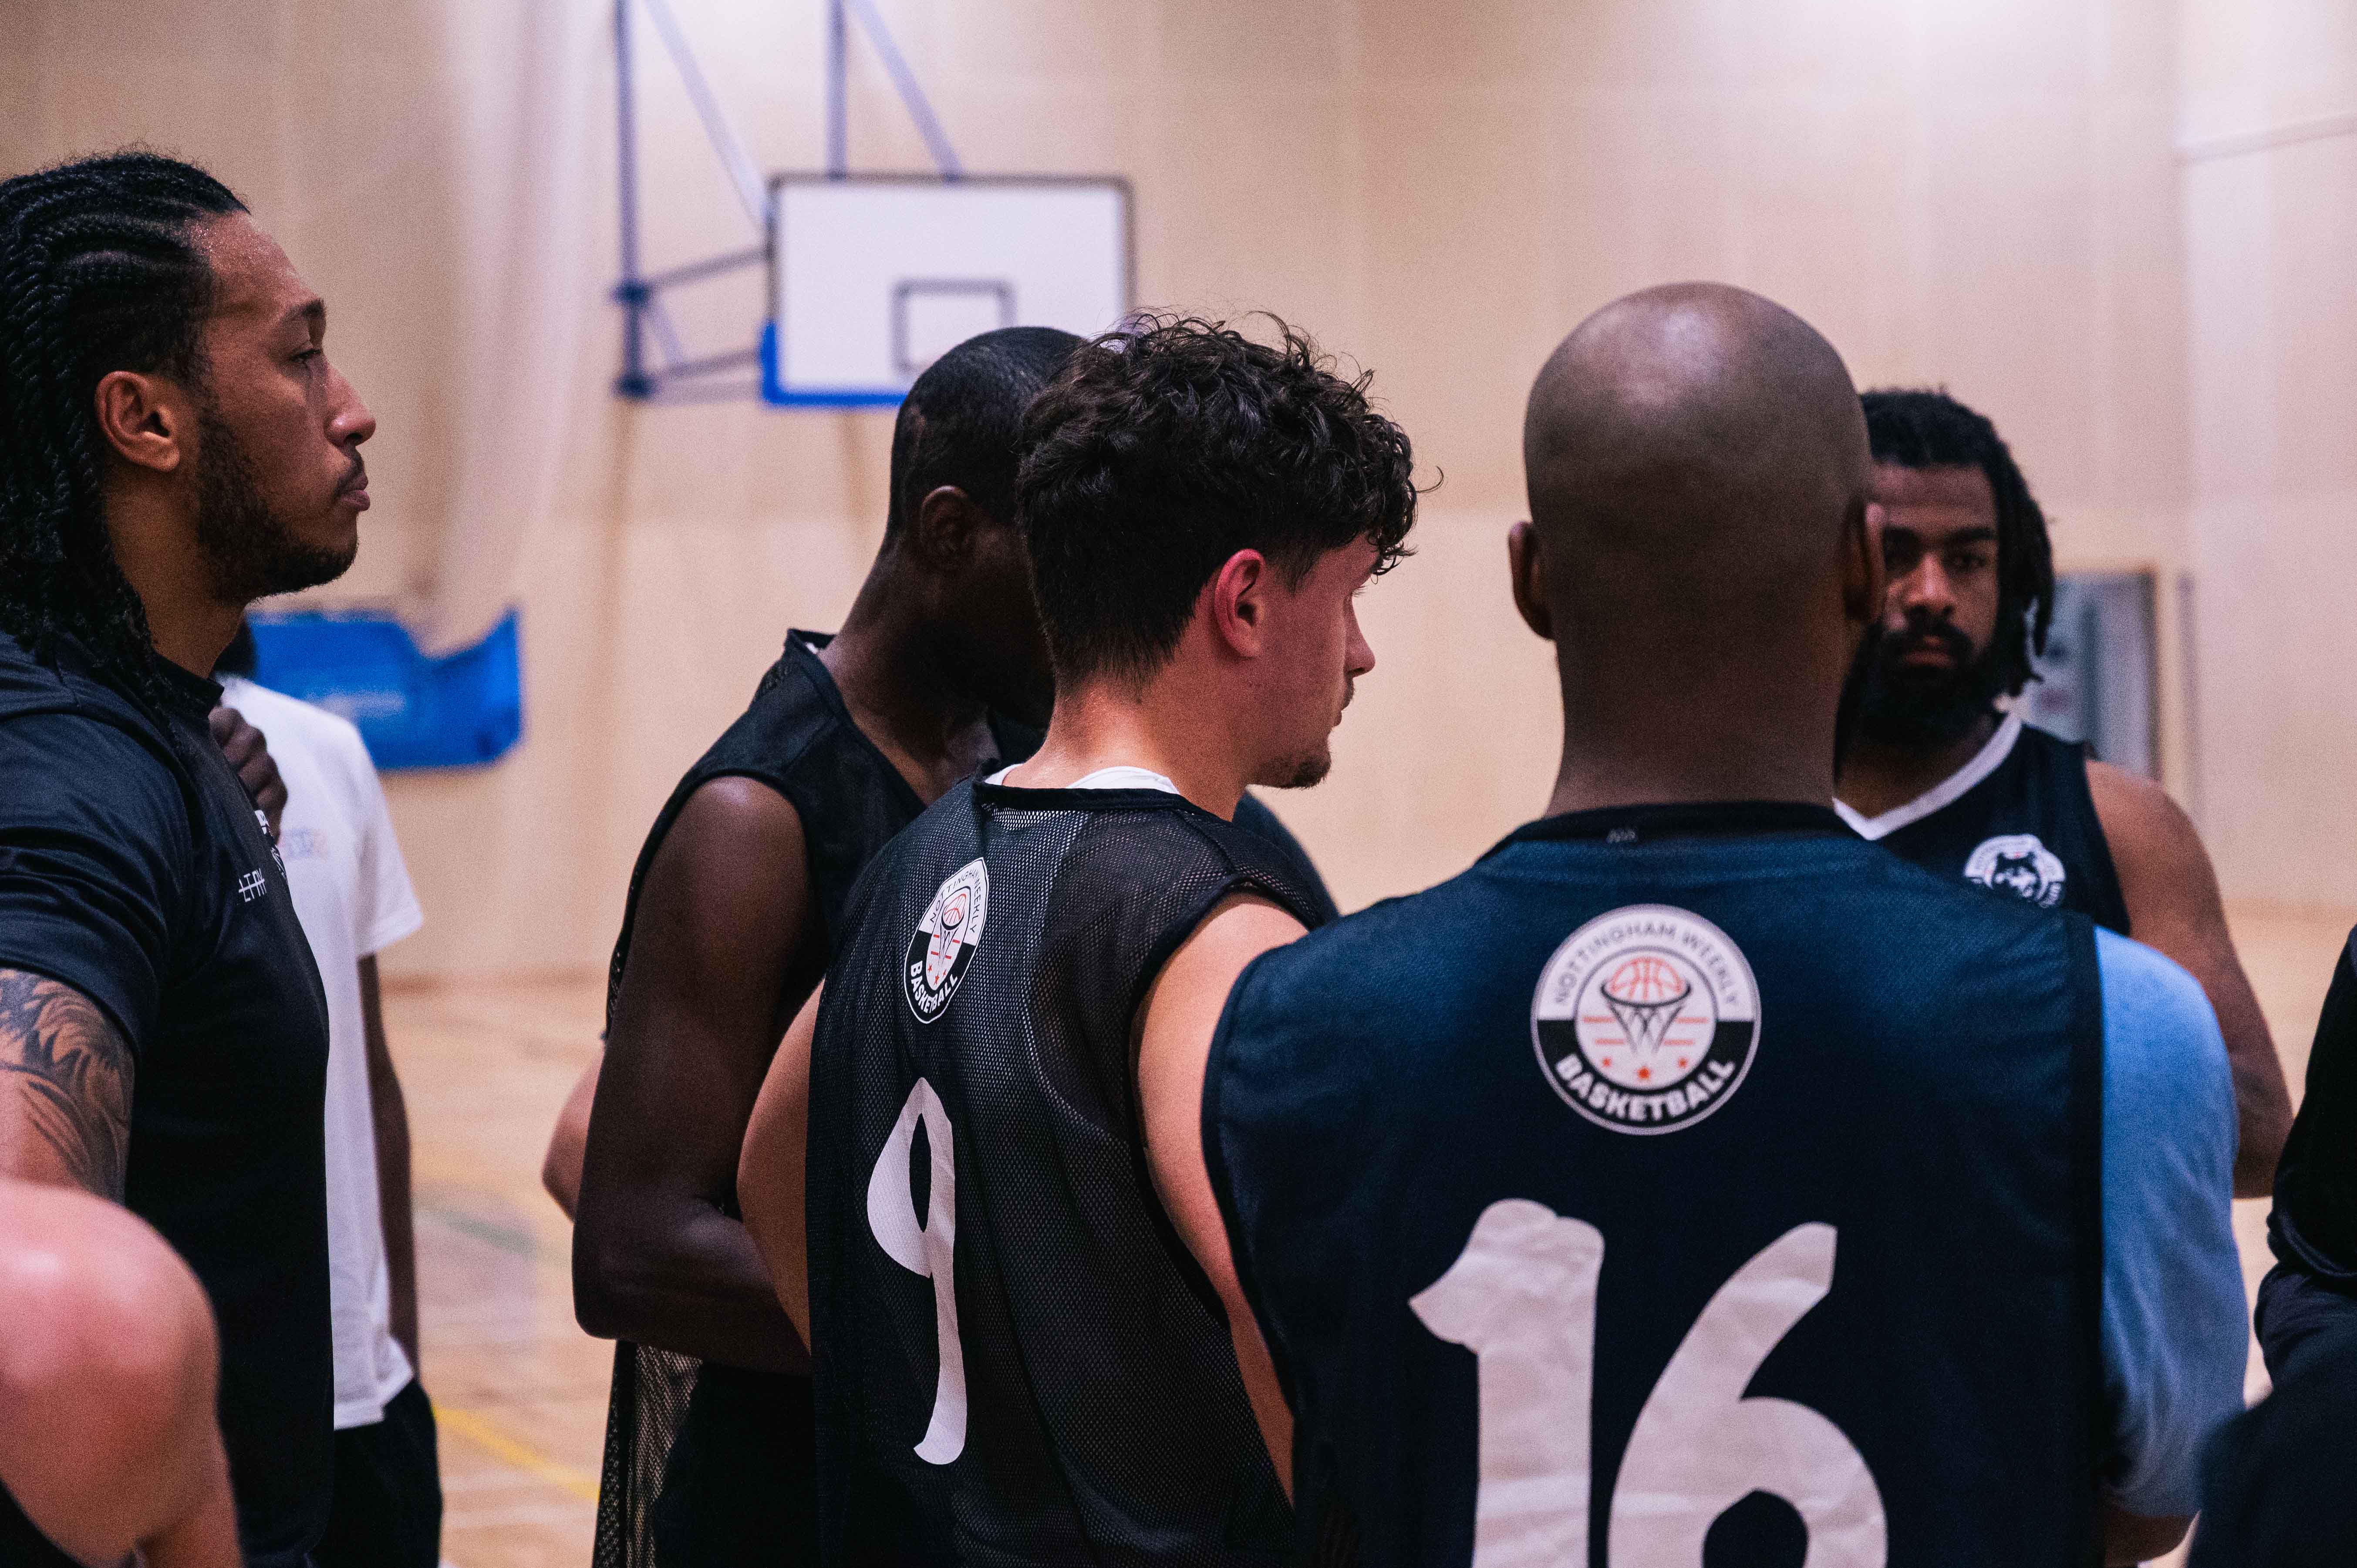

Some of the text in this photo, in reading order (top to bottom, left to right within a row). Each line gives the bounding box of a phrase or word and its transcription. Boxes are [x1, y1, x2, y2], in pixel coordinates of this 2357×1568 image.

[930, 868, 981, 933] NOTTINGHAM WEEKLY
[910, 960, 958, 1013] BASKETBALL
[1555, 921, 1739, 1005] NOTTINGHAM WEEKLY
[1554, 1053, 1736, 1122] BASKETBALL
[867, 1077, 968, 1465] 9
[1408, 1198, 1889, 1568] 16
